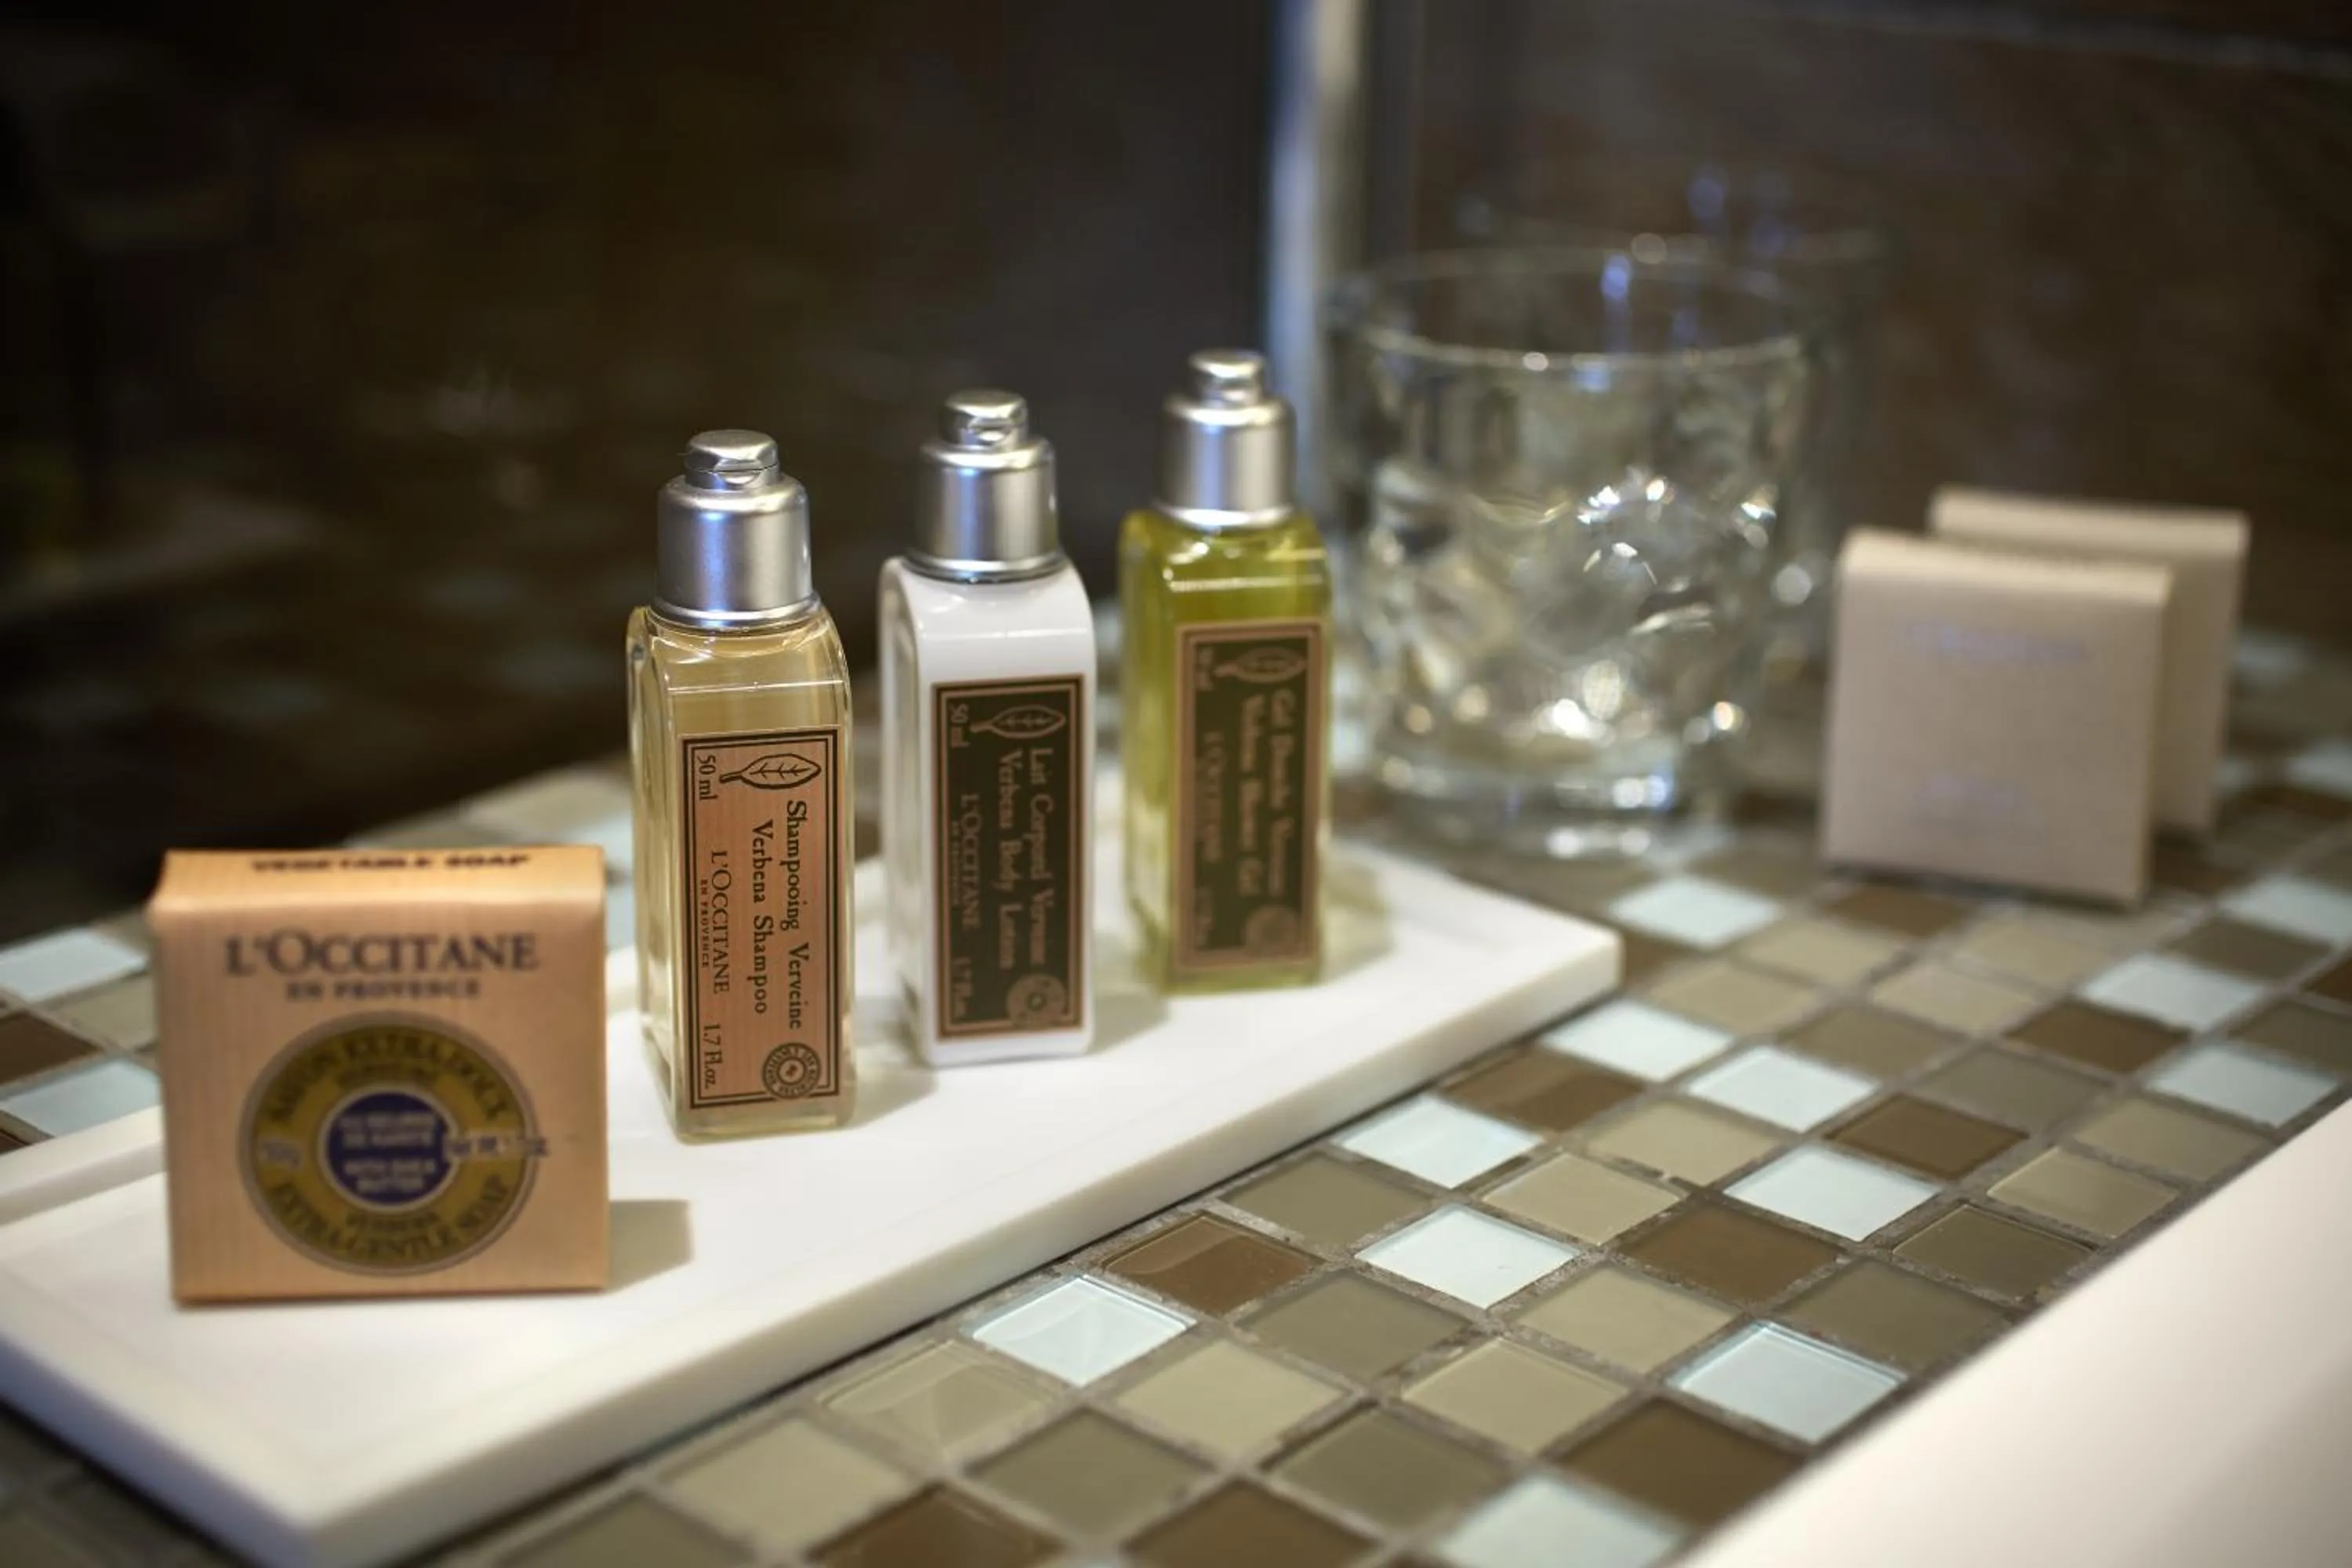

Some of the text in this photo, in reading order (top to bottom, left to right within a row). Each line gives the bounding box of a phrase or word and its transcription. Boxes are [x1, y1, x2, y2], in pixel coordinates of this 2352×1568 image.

[951, 703, 969, 724] 50
[697, 754, 719, 801] 50 ml
[999, 750, 1022, 829] Verbena
[1031, 747, 1054, 786] Lait
[779, 800, 808, 931] Shampooing
[991, 840, 1022, 892] Body
[711, 850, 732, 995] L'OCCITANE
[746, 818, 775, 1014] Verbena Shampoo
[223, 926, 543, 978] L'OCCITANE
[333, 976, 481, 1000] PROVENCE
[789, 942, 810, 1029] Verveine
[702, 1023, 721, 1046] 1.7
